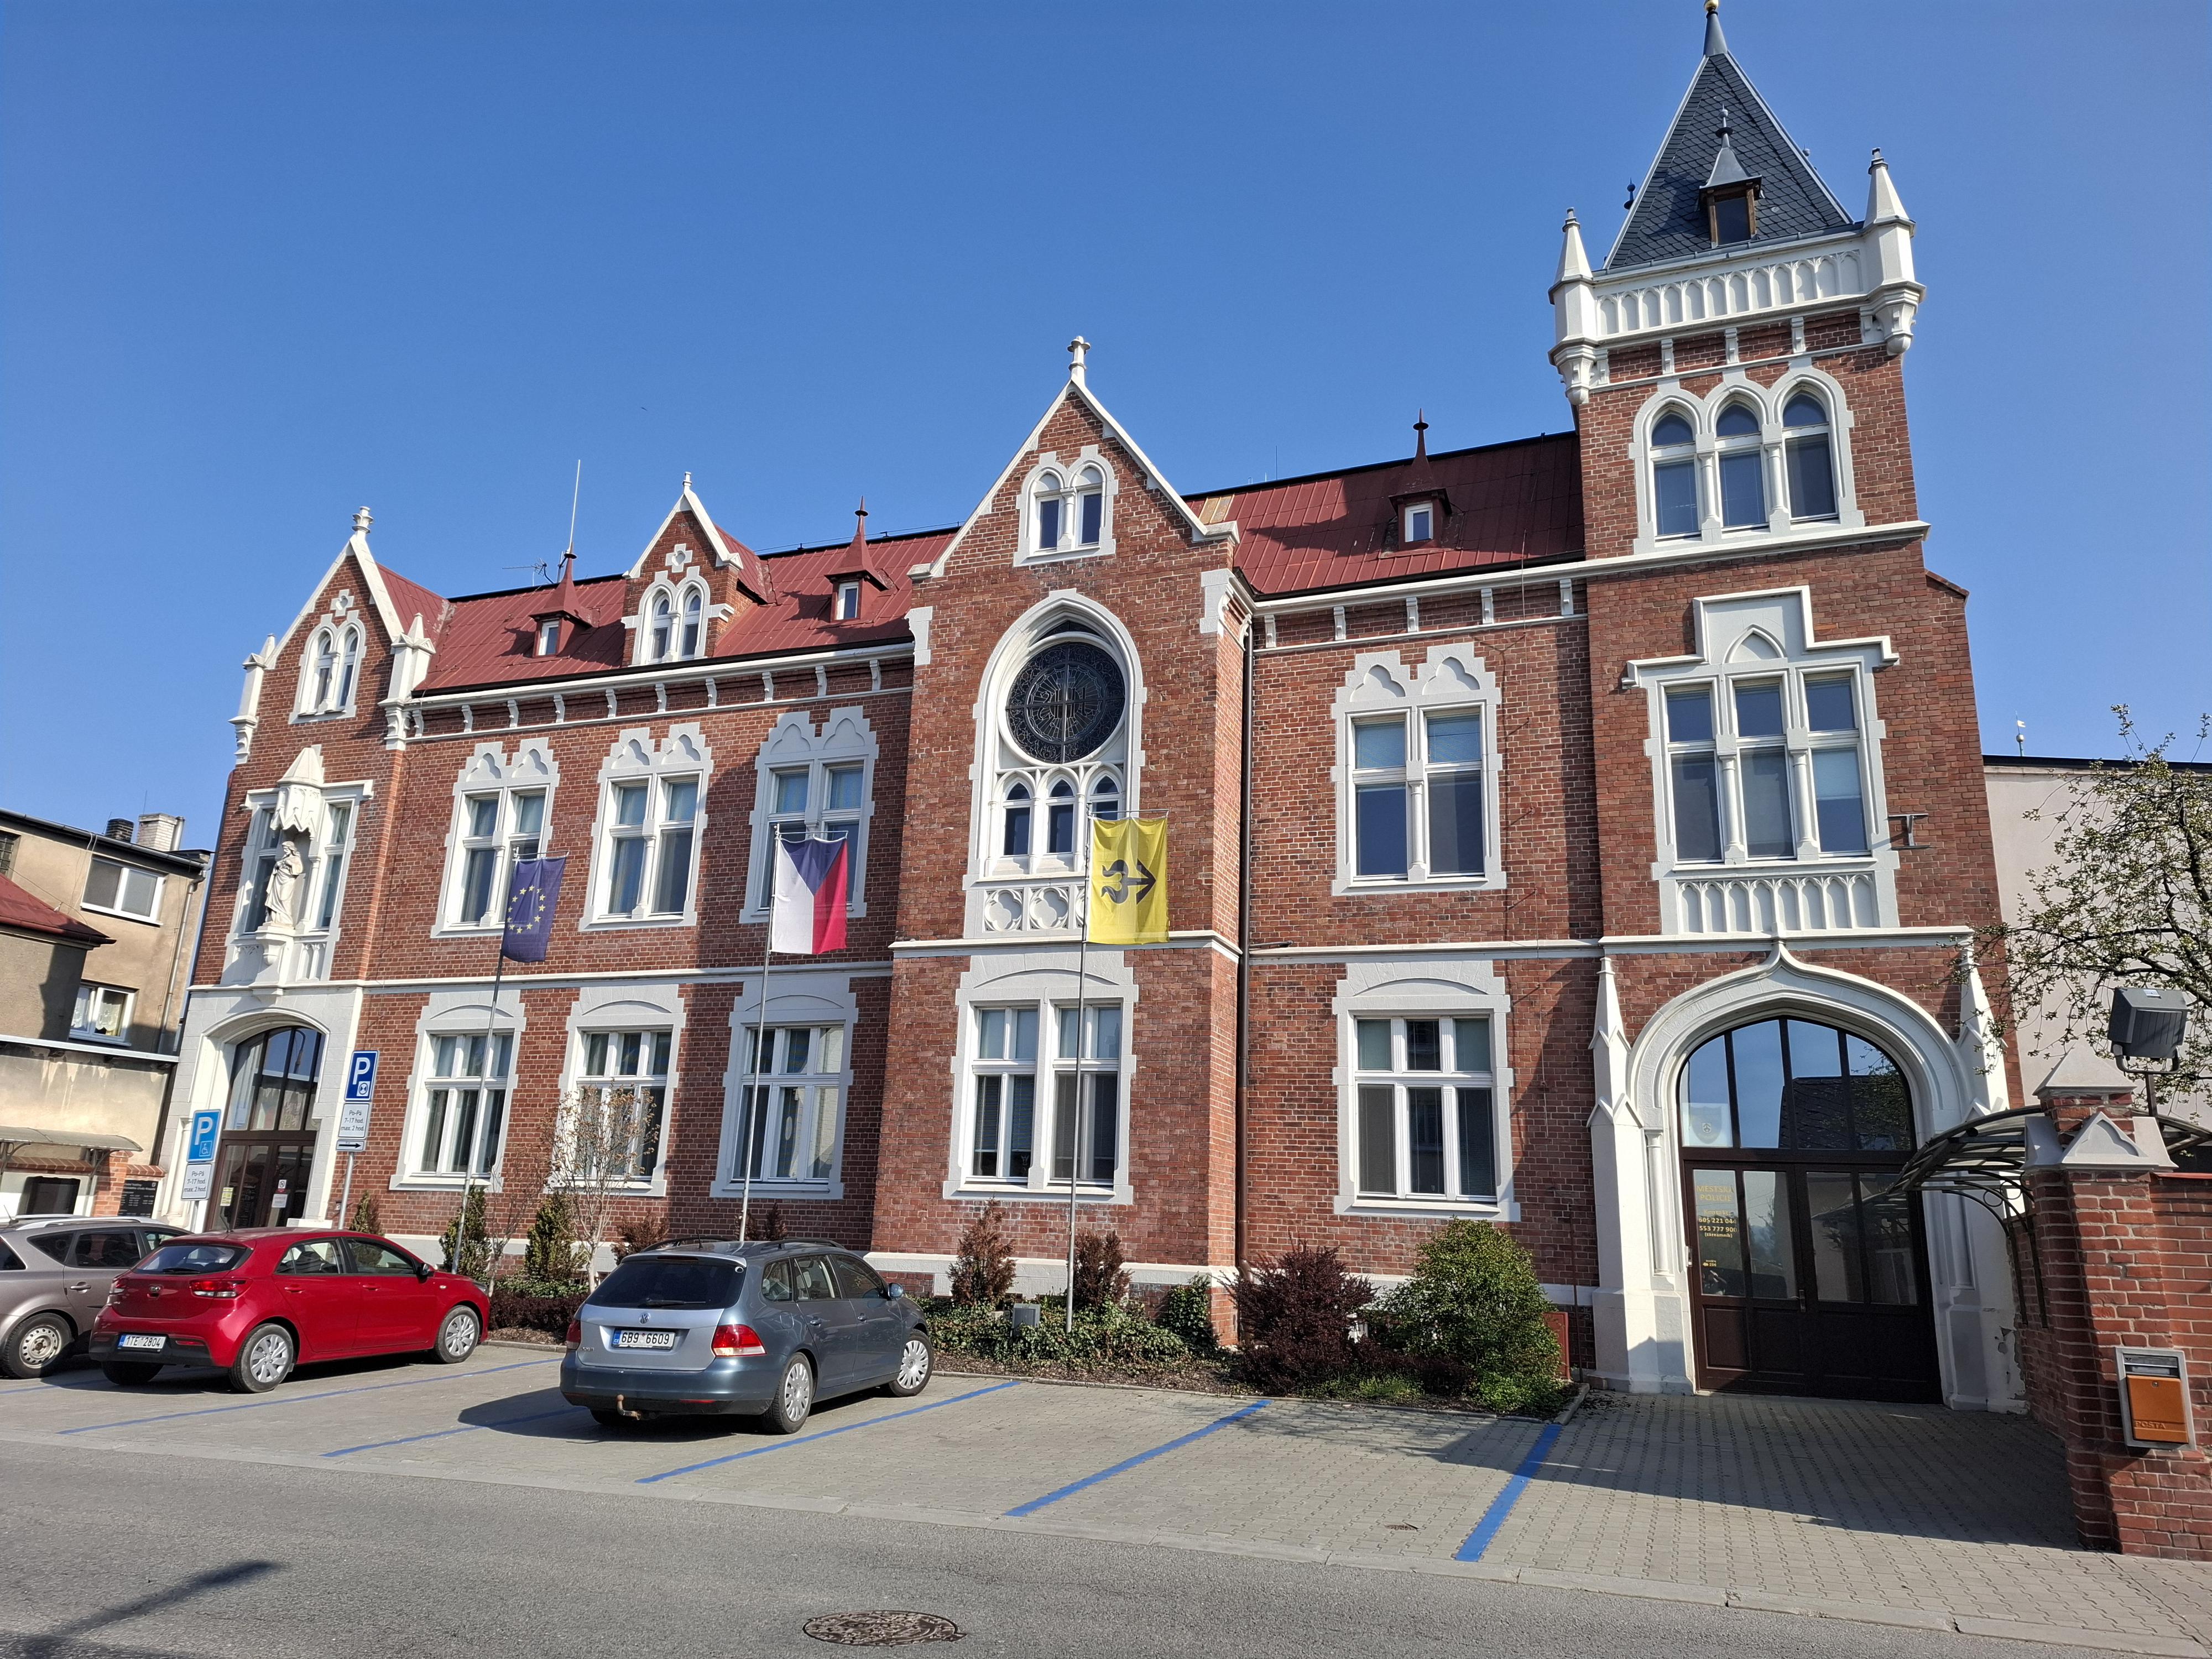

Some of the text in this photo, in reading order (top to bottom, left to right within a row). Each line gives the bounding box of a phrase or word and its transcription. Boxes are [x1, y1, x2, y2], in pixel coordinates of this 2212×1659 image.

[352, 1057, 371, 1084] P
[195, 1117, 213, 1145] P
[126, 1336, 139, 1346] 1TE
[143, 1337, 161, 1347] 2804
[621, 1332, 670, 1345] 6B9 6609
